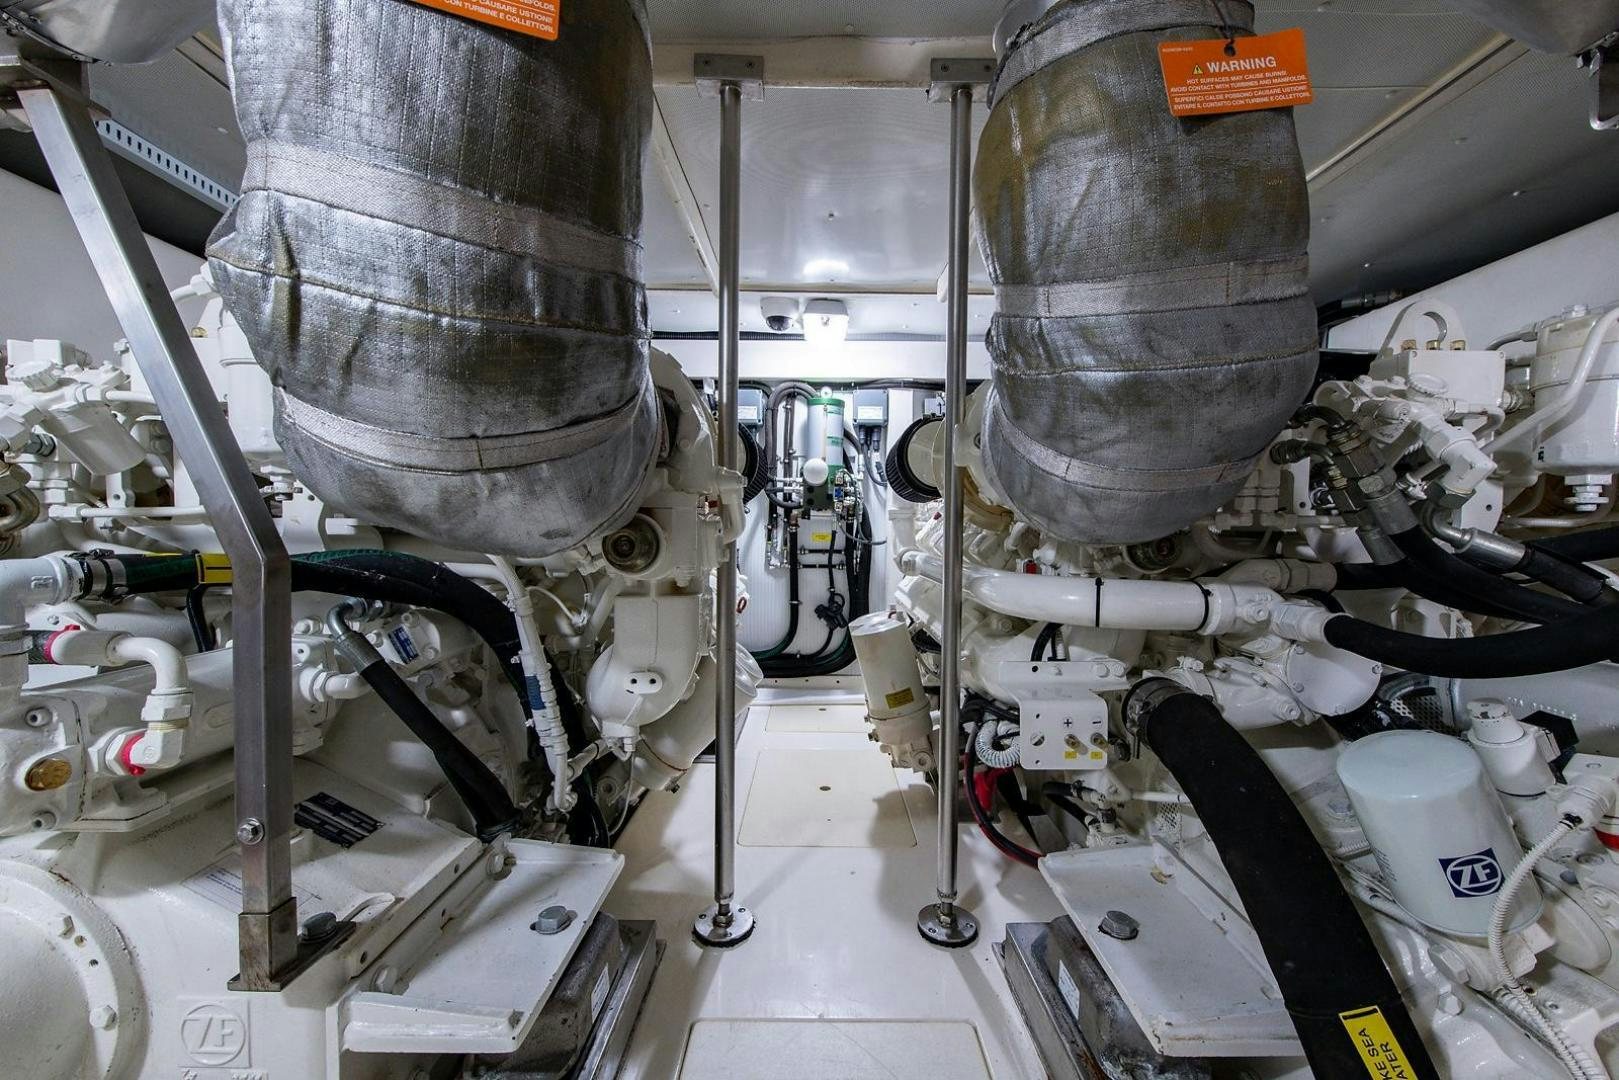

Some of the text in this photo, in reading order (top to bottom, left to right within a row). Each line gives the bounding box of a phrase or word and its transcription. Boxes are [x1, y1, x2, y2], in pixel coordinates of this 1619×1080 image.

[464, 2, 498, 18] TURBINE
[499, 12, 505, 20] E
[1200, 76, 1230, 84] SURFACES
[1206, 56, 1277, 73] WARNING
[1448, 858, 1500, 890] ZF
[183, 1014, 242, 1054] ZF
[1358, 1027, 1380, 1058] SEA
[1380, 1041, 1408, 1080] ATER
